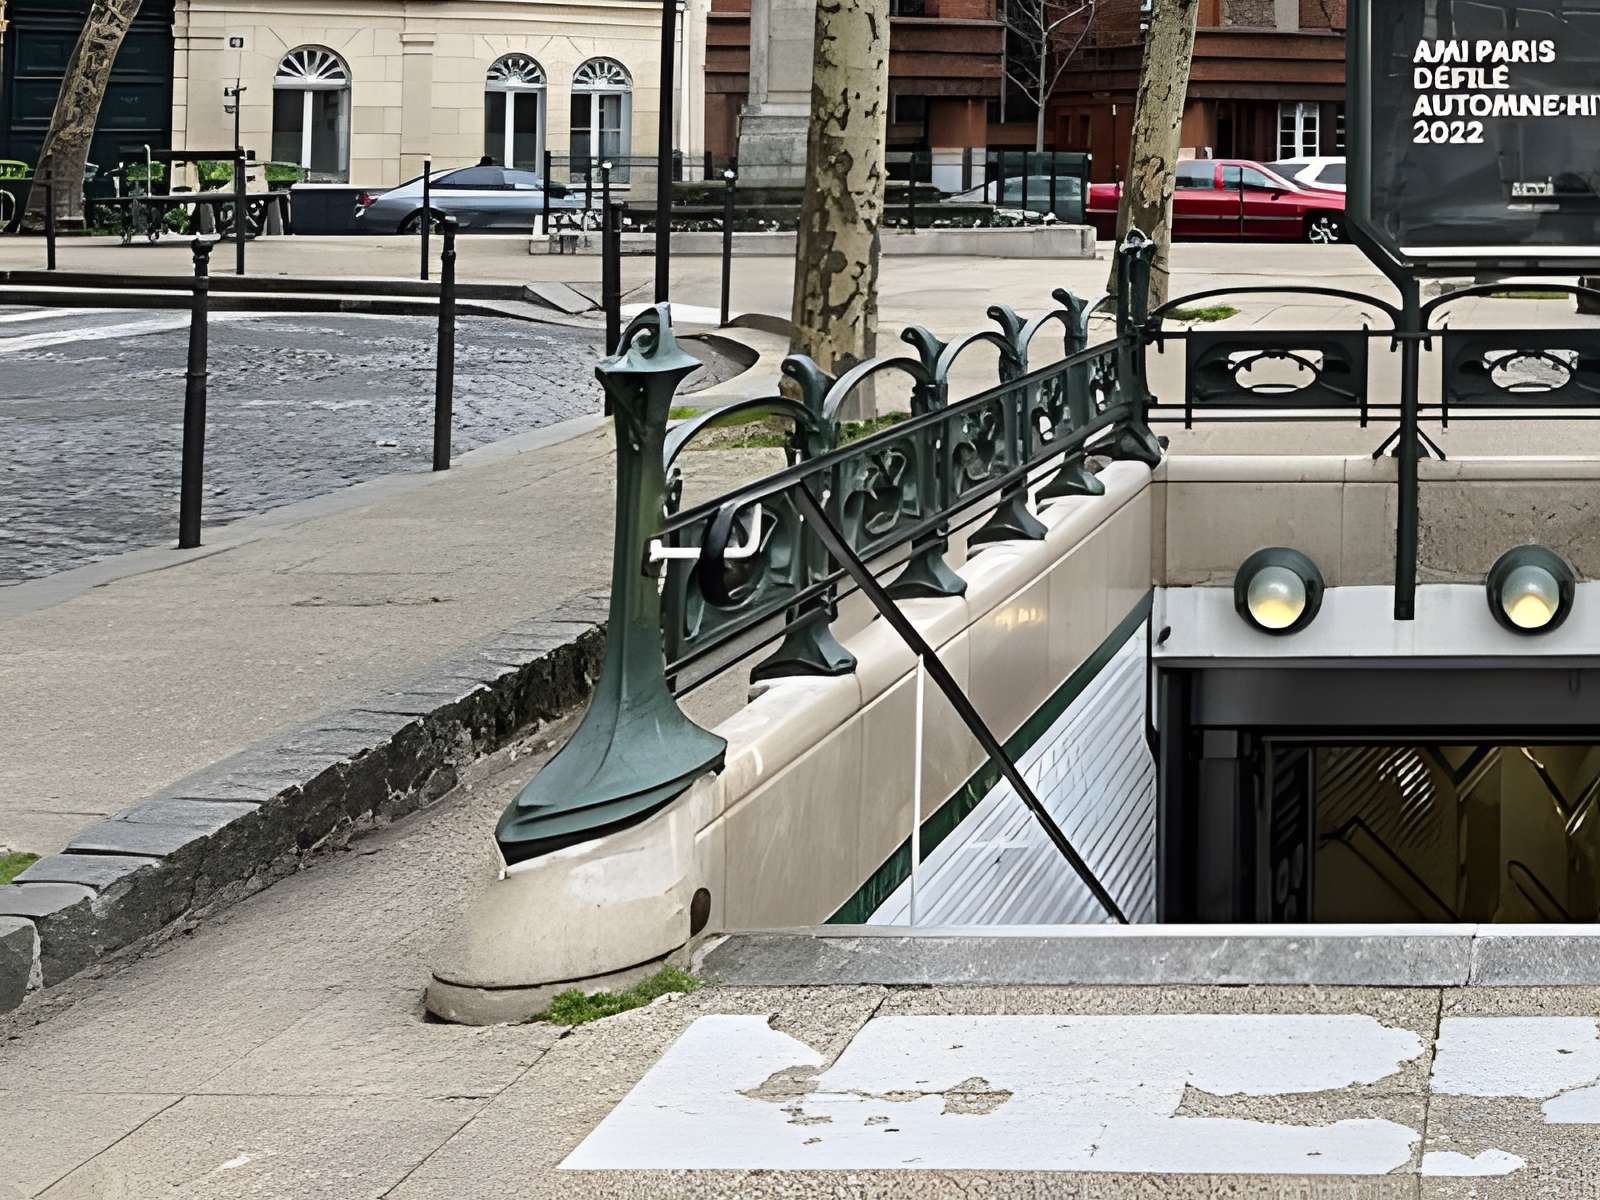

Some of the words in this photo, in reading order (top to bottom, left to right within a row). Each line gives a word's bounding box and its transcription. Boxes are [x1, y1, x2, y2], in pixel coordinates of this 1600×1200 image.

[1412, 39, 1469, 63] AMI
[1475, 39, 1556, 63] PARIS
[1413, 64, 1510, 89] DÉFILÉ
[1412, 119, 1484, 144] 2022
